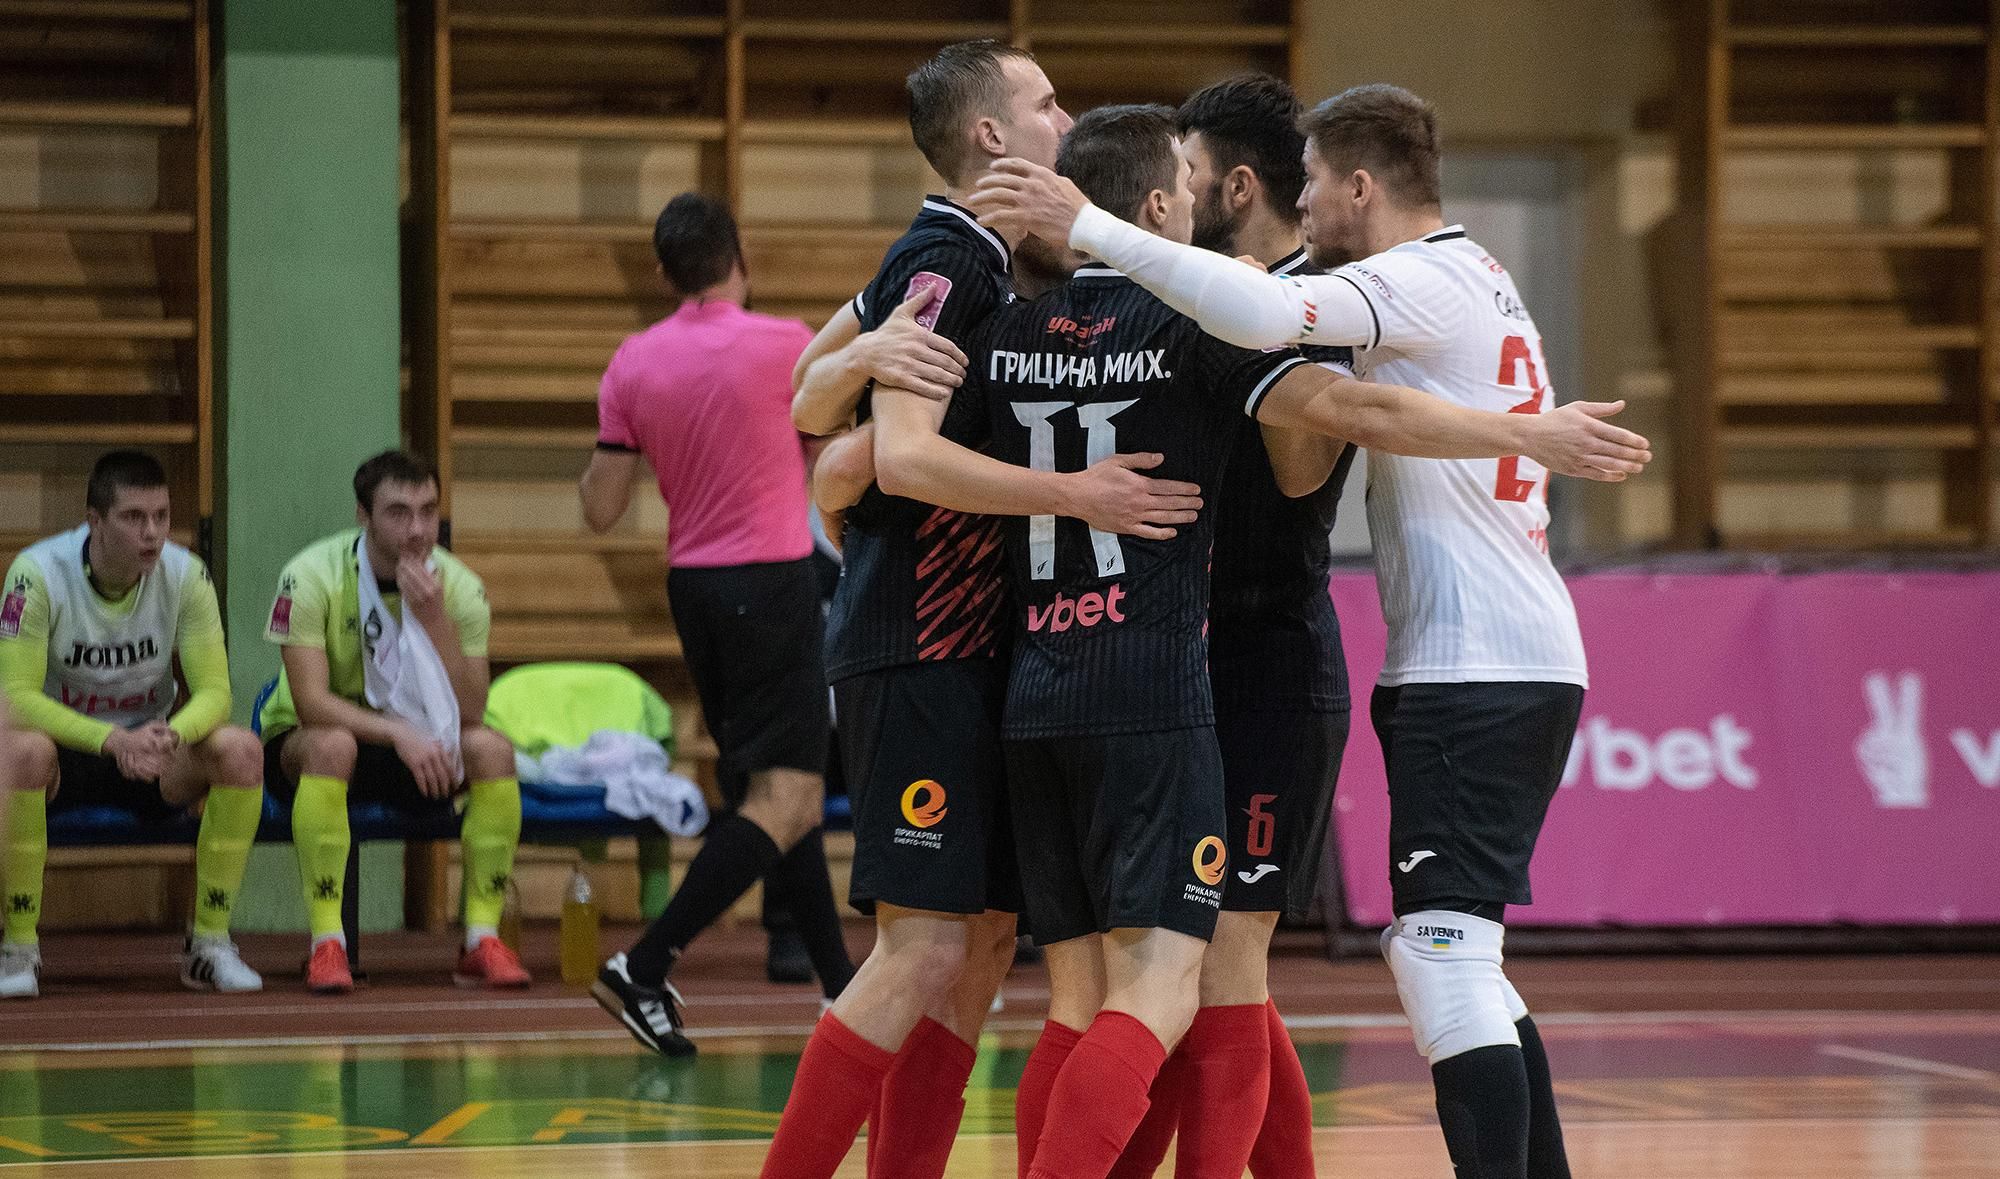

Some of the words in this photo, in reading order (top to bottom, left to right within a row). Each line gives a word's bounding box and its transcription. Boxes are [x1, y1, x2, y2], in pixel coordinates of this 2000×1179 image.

[989, 350, 1098, 390] ГРИЦИНА
[1102, 349, 1172, 385] МИХ.
[1010, 397, 1141, 580] 11
[1027, 583, 1126, 633] vbet
[1241, 793, 1278, 857] 6
[1417, 926, 1464, 940] SAVENKO
